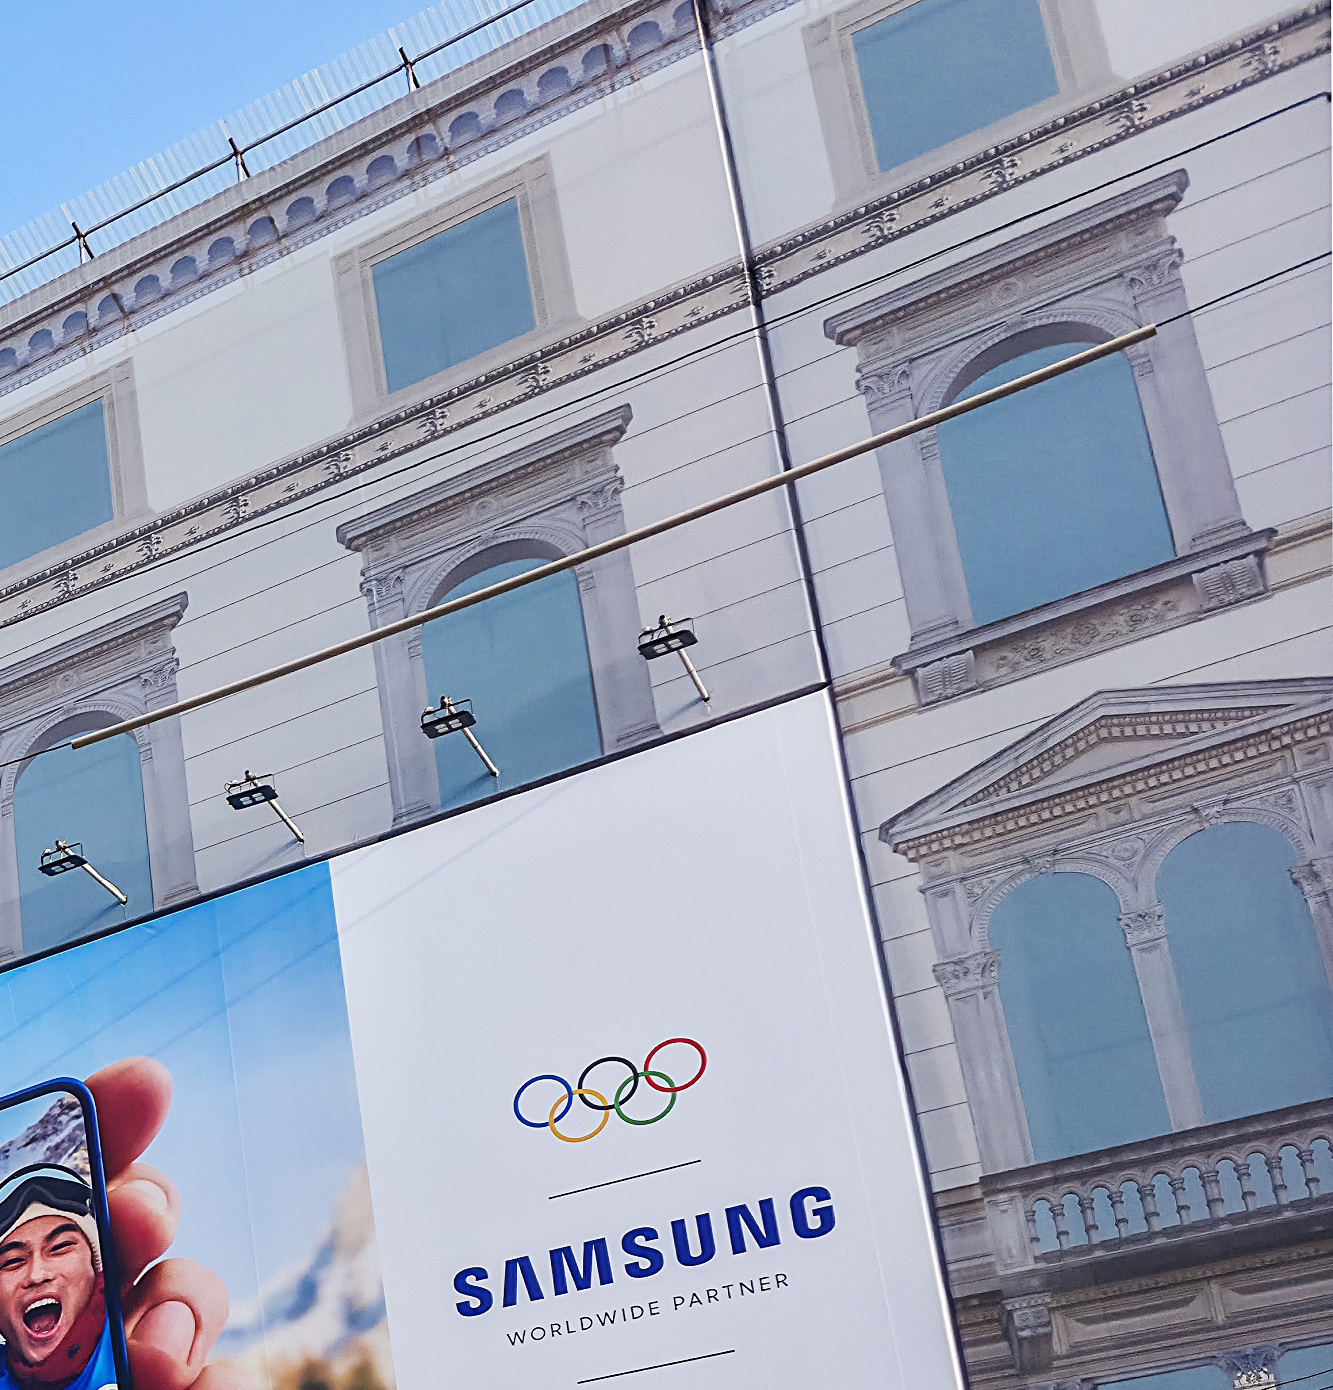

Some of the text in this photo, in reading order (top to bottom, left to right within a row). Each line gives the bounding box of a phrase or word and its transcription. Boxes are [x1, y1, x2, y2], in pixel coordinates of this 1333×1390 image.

[453, 1185, 836, 1318] SAMSUNG
[506, 1273, 789, 1347] WORLDWIDE PARTNER
